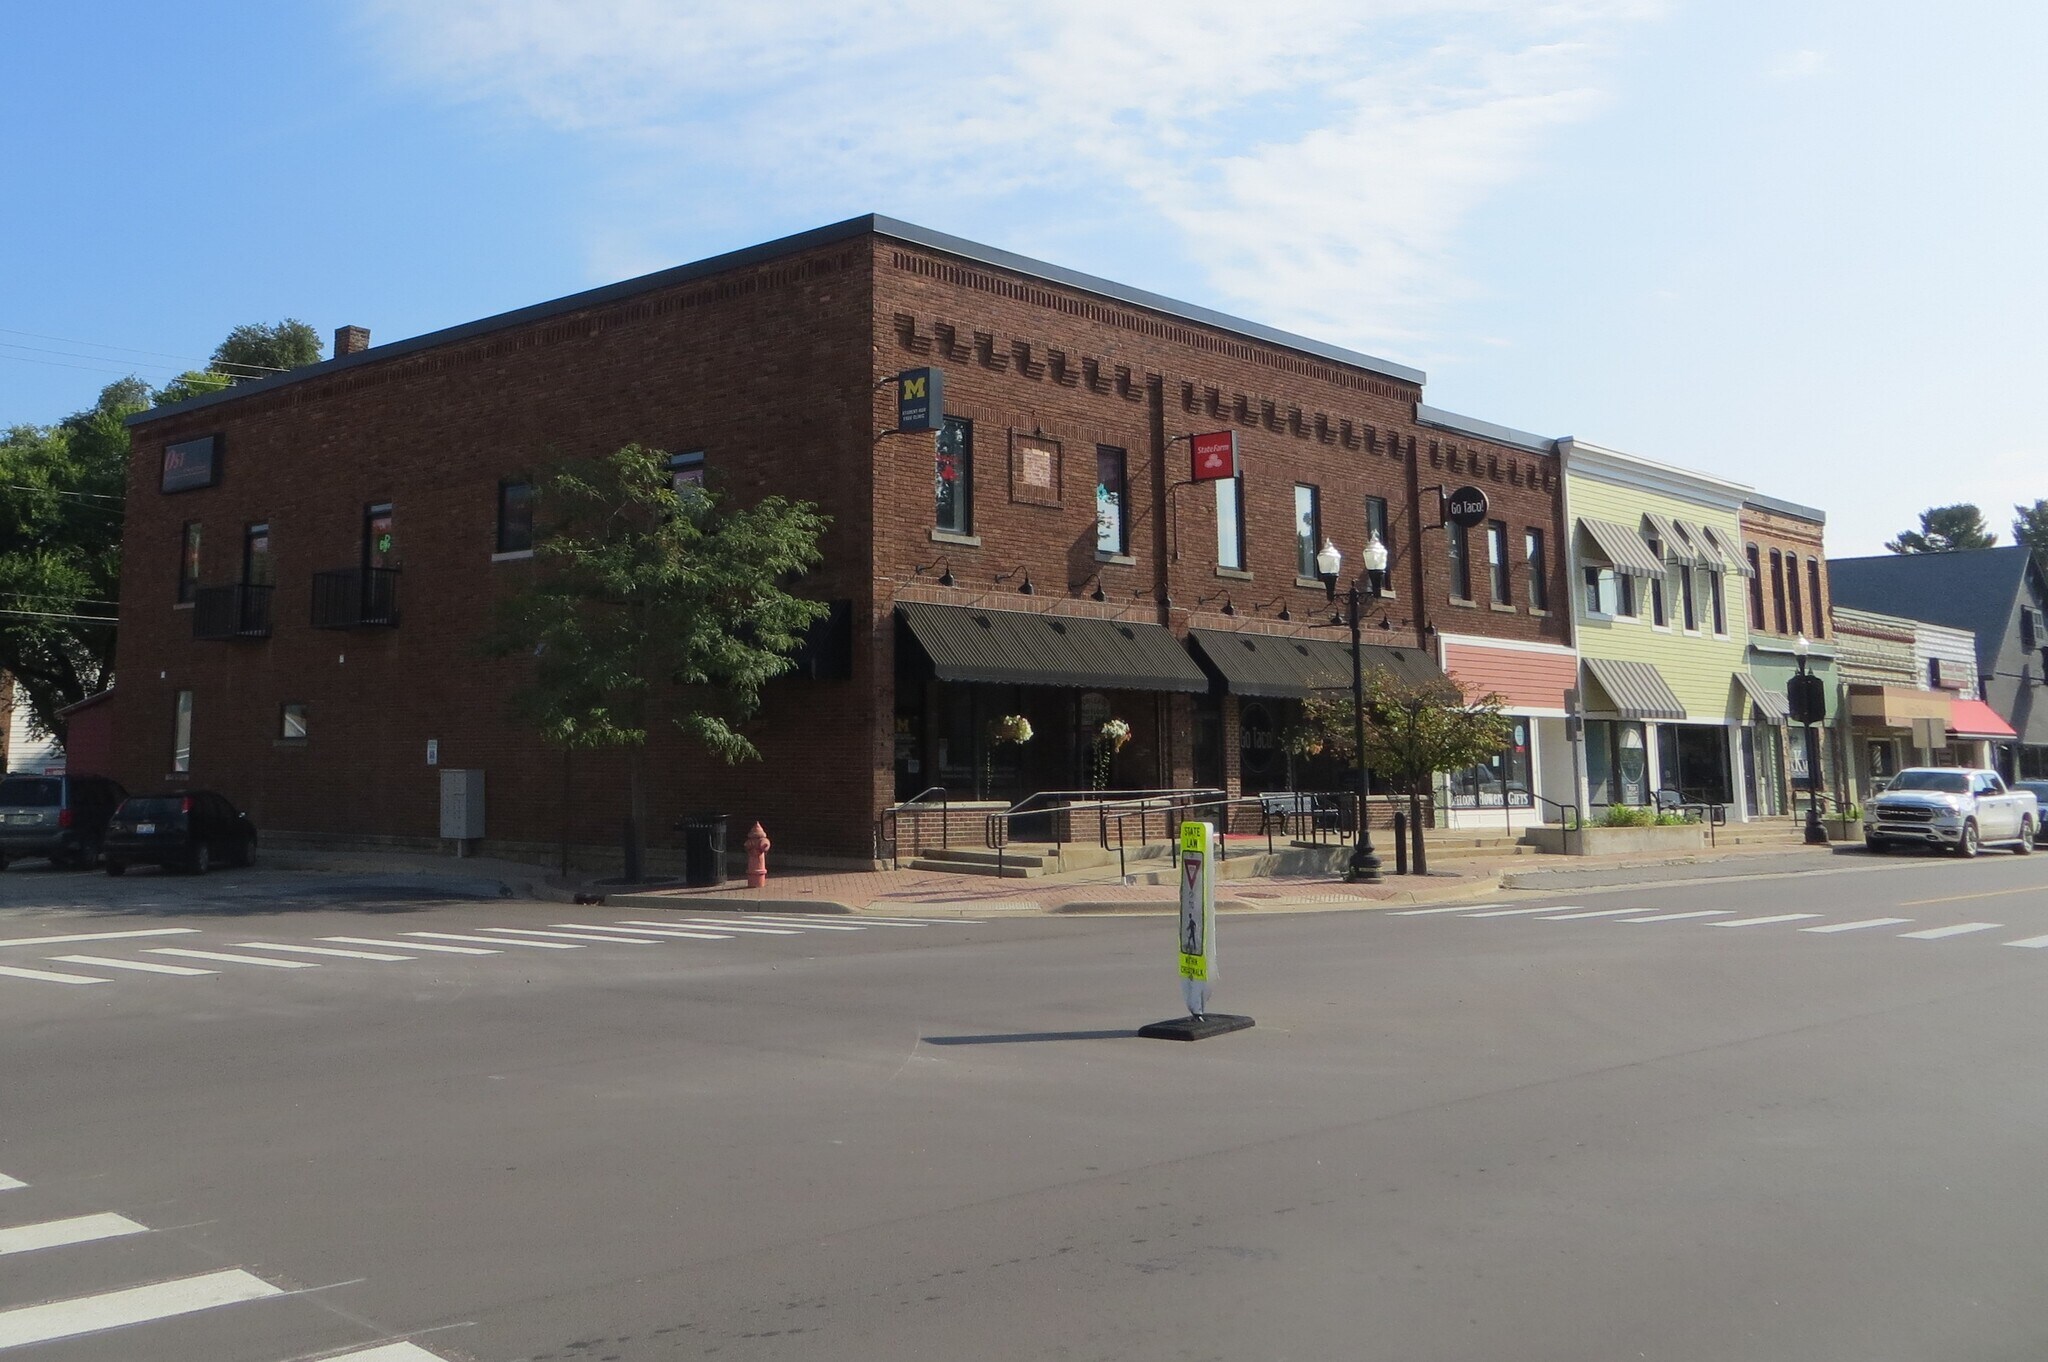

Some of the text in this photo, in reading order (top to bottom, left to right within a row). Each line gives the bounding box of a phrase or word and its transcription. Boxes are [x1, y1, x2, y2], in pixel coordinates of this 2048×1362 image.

[904, 377, 926, 401] M
[1451, 500, 1484, 514] Go Taco!
[1184, 827, 1201, 837] STATE
[1186, 838, 1198, 848] LAW
